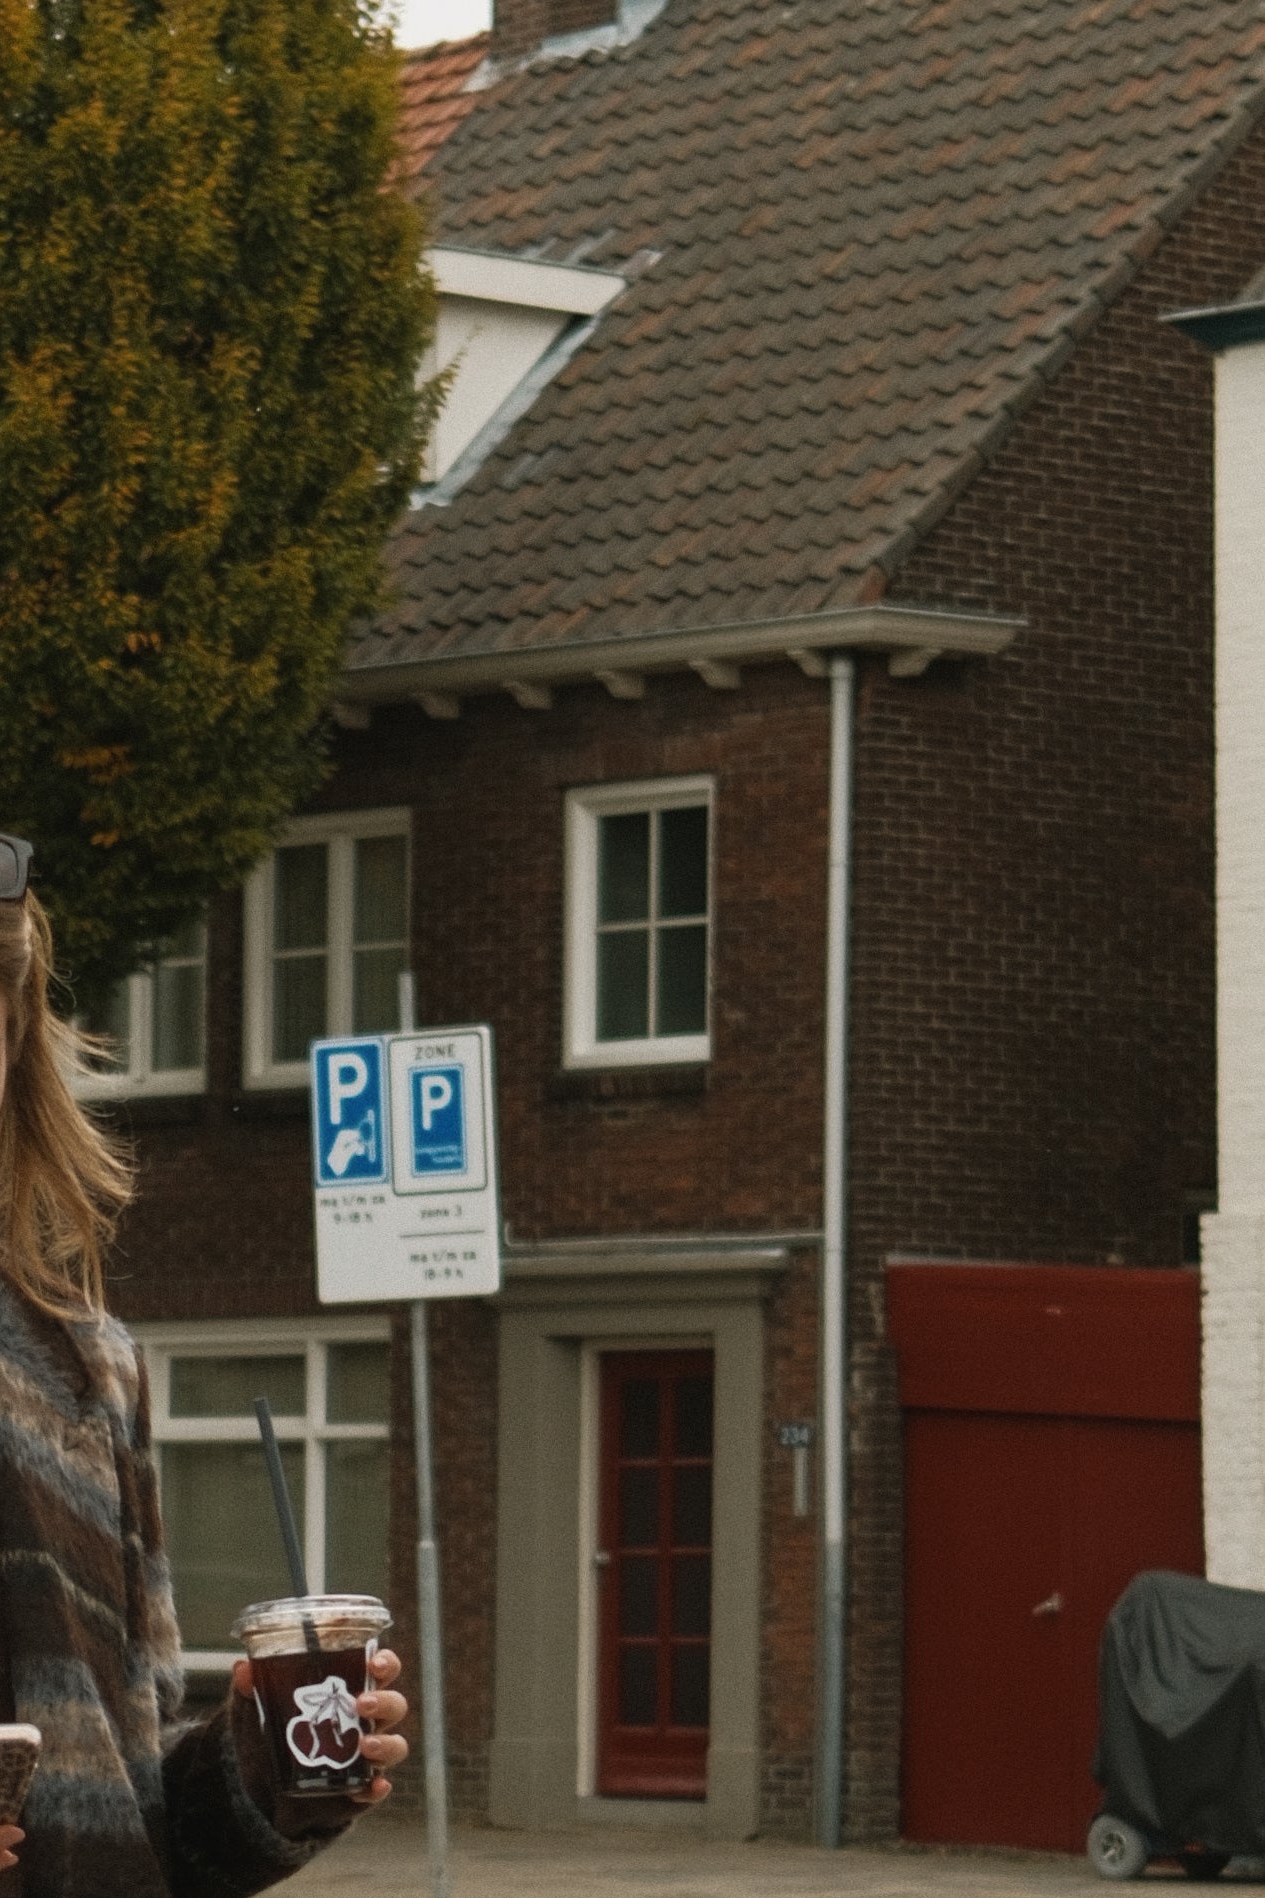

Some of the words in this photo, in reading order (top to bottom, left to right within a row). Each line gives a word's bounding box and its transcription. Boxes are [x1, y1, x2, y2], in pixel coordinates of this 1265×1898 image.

[415, 1044, 456, 1060] ZONE
[328, 1053, 368, 1125] P
[421, 1075, 451, 1130] P
